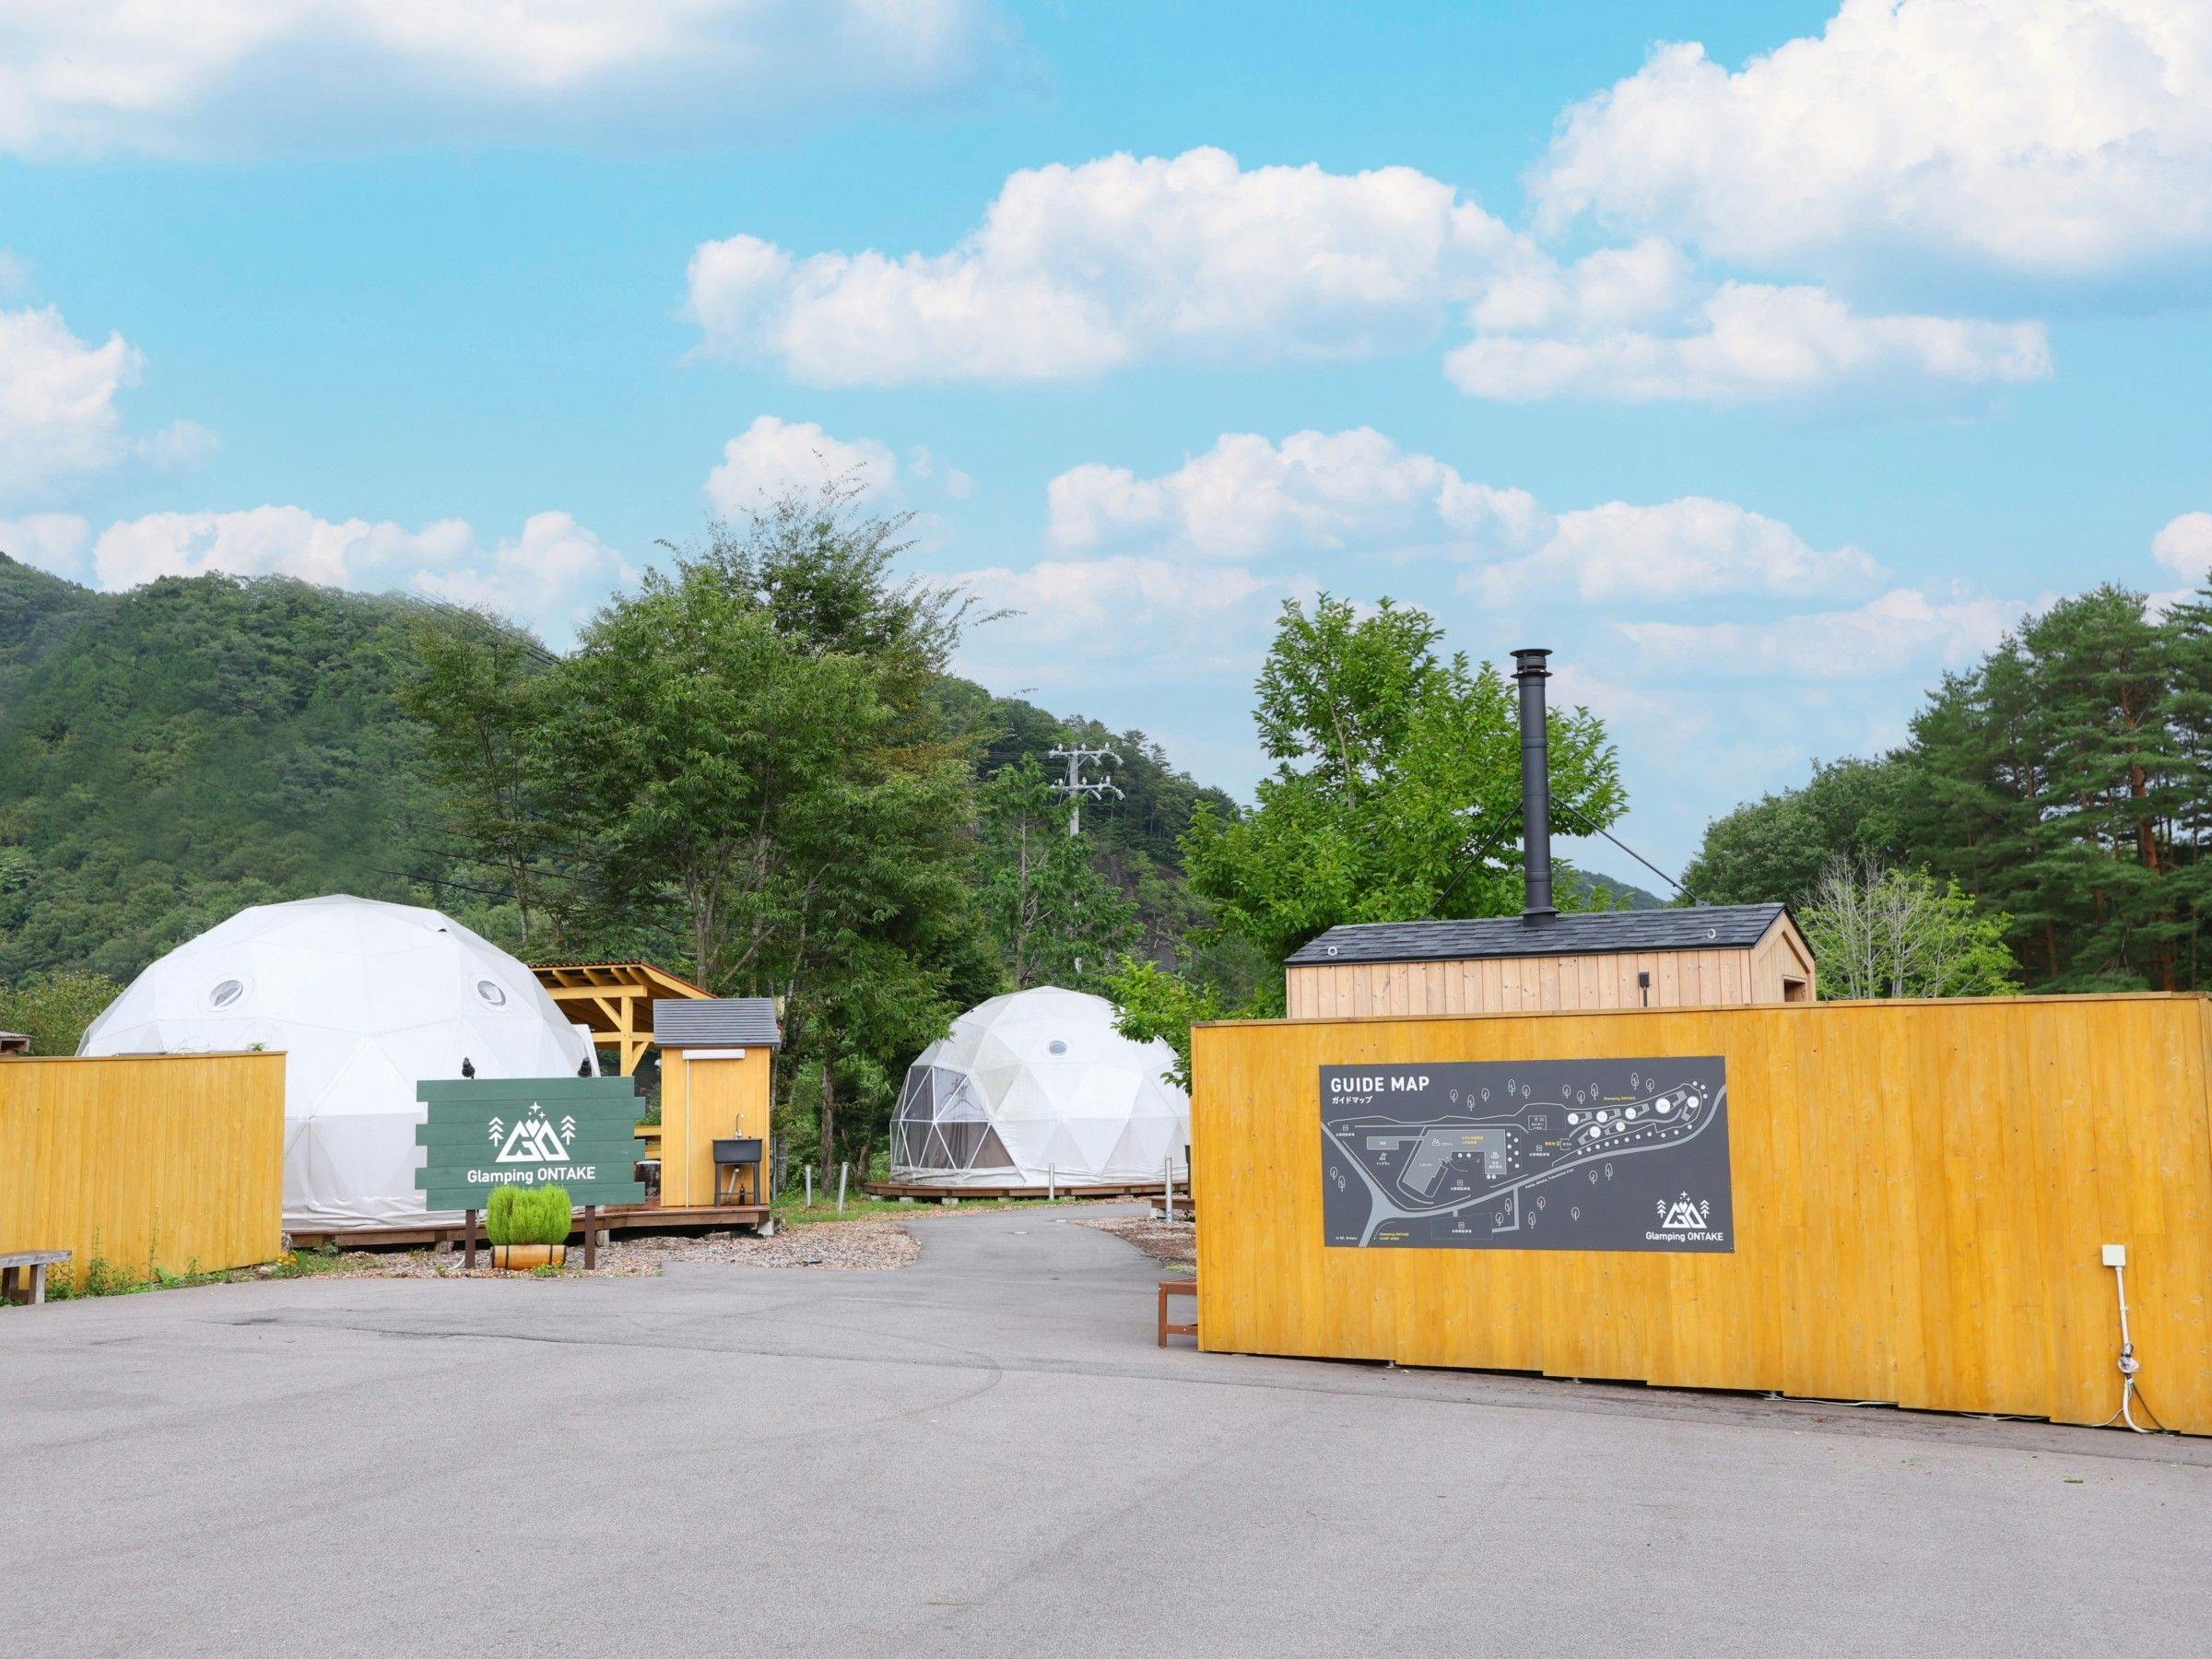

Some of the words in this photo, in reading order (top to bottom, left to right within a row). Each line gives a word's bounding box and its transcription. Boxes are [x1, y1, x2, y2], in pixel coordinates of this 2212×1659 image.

[1331, 1077, 1384, 1092] GUIDE
[1392, 1076, 1430, 1091] MAP
[1332, 1096, 1372, 1104] ガイドマップ
[467, 1169, 534, 1185] Glamping
[537, 1166, 595, 1181] ONTAKE
[1645, 1231, 1686, 1242] Glamping
[1688, 1231, 1724, 1241] ONTAKE
